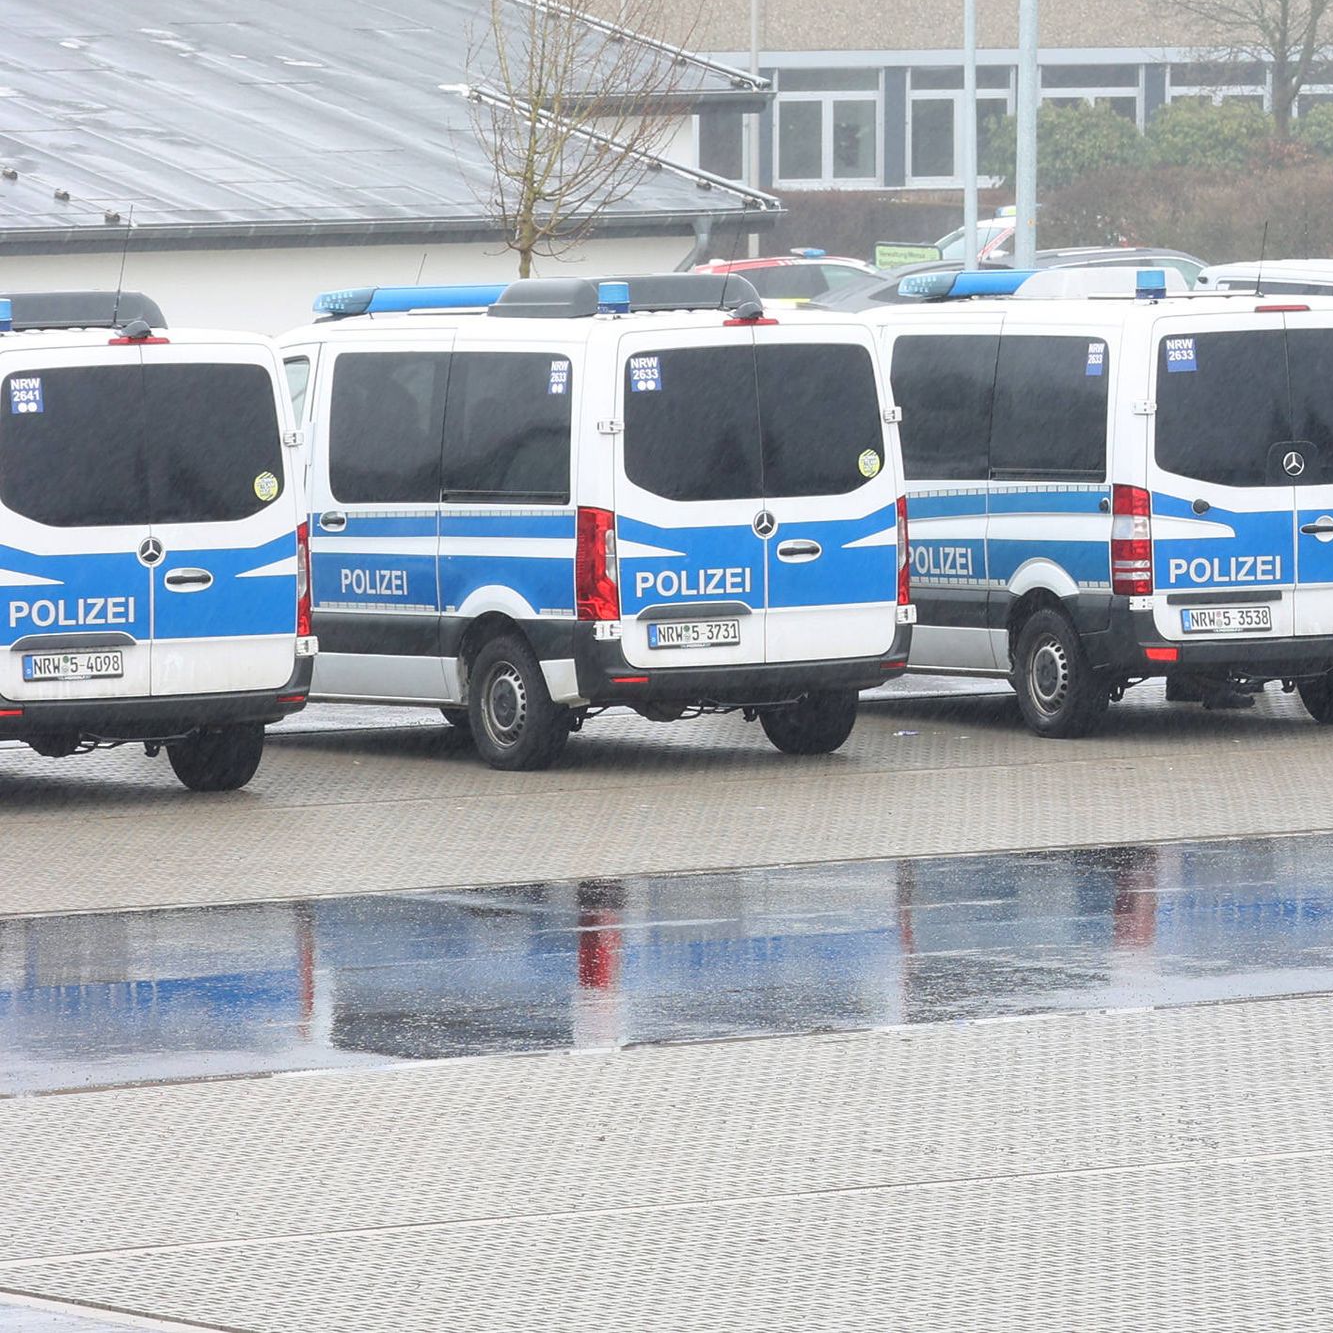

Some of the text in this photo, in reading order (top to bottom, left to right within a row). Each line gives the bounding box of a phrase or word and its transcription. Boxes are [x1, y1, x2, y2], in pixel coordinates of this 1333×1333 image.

[1088, 343, 1105, 353] NRW
[1166, 338, 1194, 350] NRW
[1088, 354, 1103, 364] 2633
[1168, 349, 1194, 361] 2633
[551, 361, 569, 371] NRW
[630, 357, 659, 369] NRW
[550, 372, 567, 383] 2633
[633, 369, 659, 380] 2633
[10, 378, 41, 390] NRW
[12, 390, 40, 402] 2641
[1169, 555, 1281, 583] POLIZEI
[341, 568, 408, 596] POLIZEI
[635, 567, 751, 598] POLIZEI
[9, 596, 135, 627] POLIZEI
[1190, 610, 1269, 627] NRW 5-3538
[658, 623, 738, 642] NRW 5-3731
[33, 655, 120, 674] NRW 5-4098
